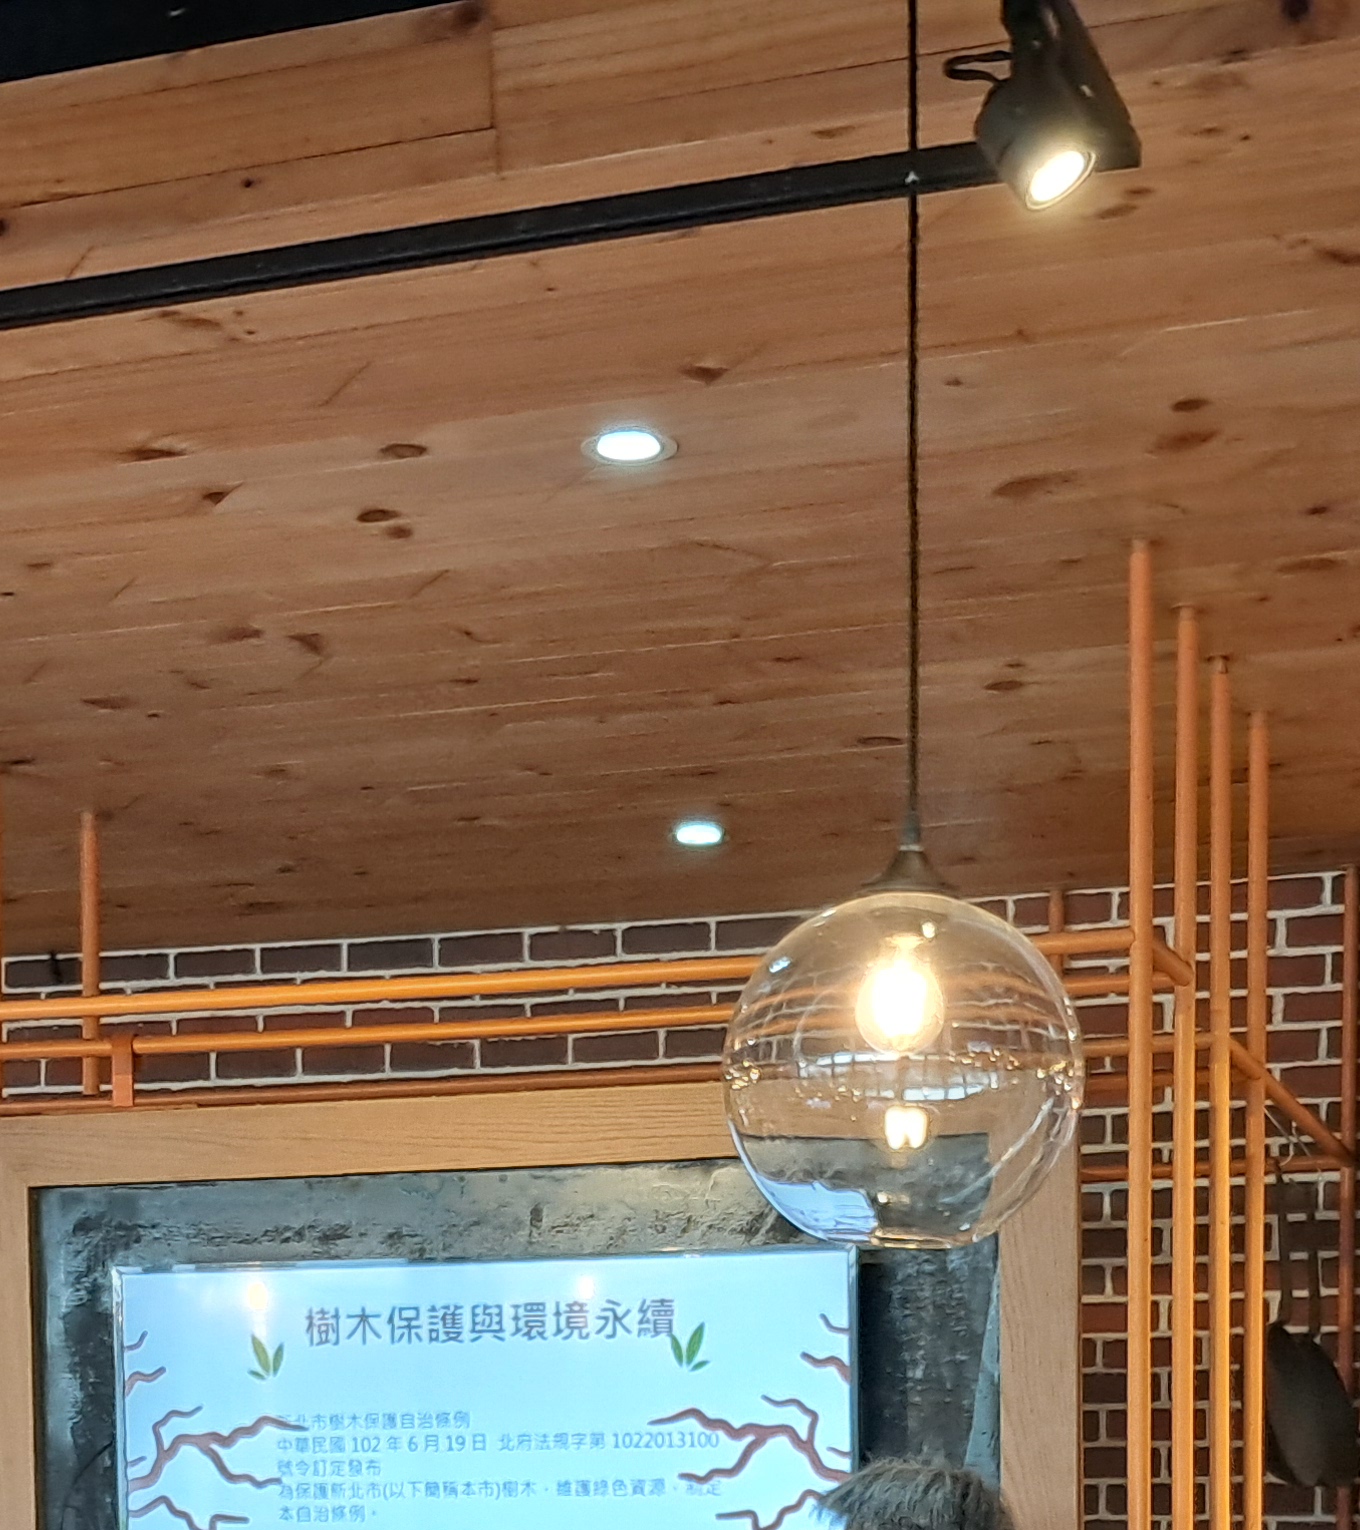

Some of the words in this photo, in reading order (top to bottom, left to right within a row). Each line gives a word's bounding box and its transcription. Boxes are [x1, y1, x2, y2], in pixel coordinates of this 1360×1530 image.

[304, 1298, 676, 1347] 樹木保護與環境永續
[352, 1436, 381, 1453] 102
[387, 1435, 403, 1453] 年
[407, 1435, 418, 1452] 6
[424, 1434, 440, 1452] 月
[446, 1434, 466, 1452] 19
[472, 1433, 487, 1452] 日
[613, 1431, 720, 1450] 1022013100
